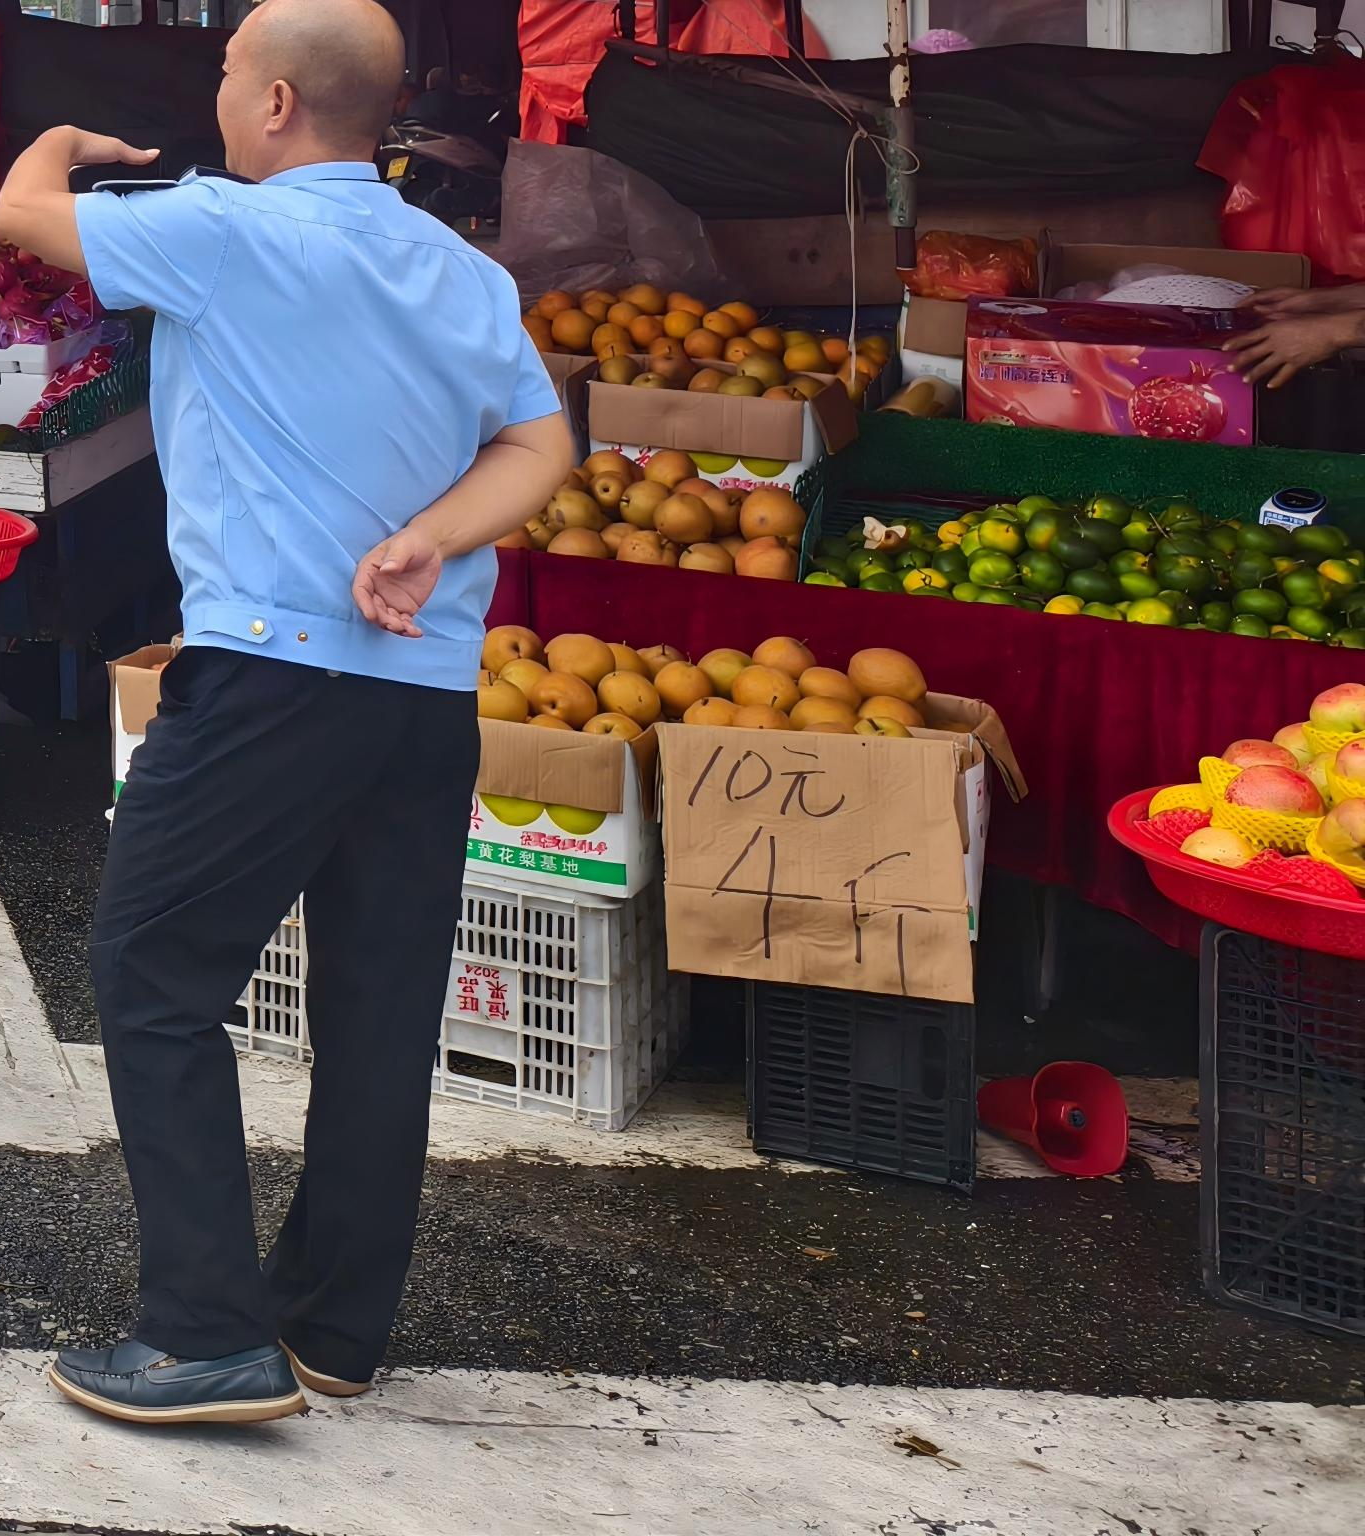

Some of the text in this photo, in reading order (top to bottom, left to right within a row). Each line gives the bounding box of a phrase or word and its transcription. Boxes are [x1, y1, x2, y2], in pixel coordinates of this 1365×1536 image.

[688, 745, 845, 817] 10元
[711, 825, 932, 995] 4斤
[465, 964, 500, 979] 2024
[458, 977, 508, 999] 果品
[456, 995, 510, 1021] 恒旺
